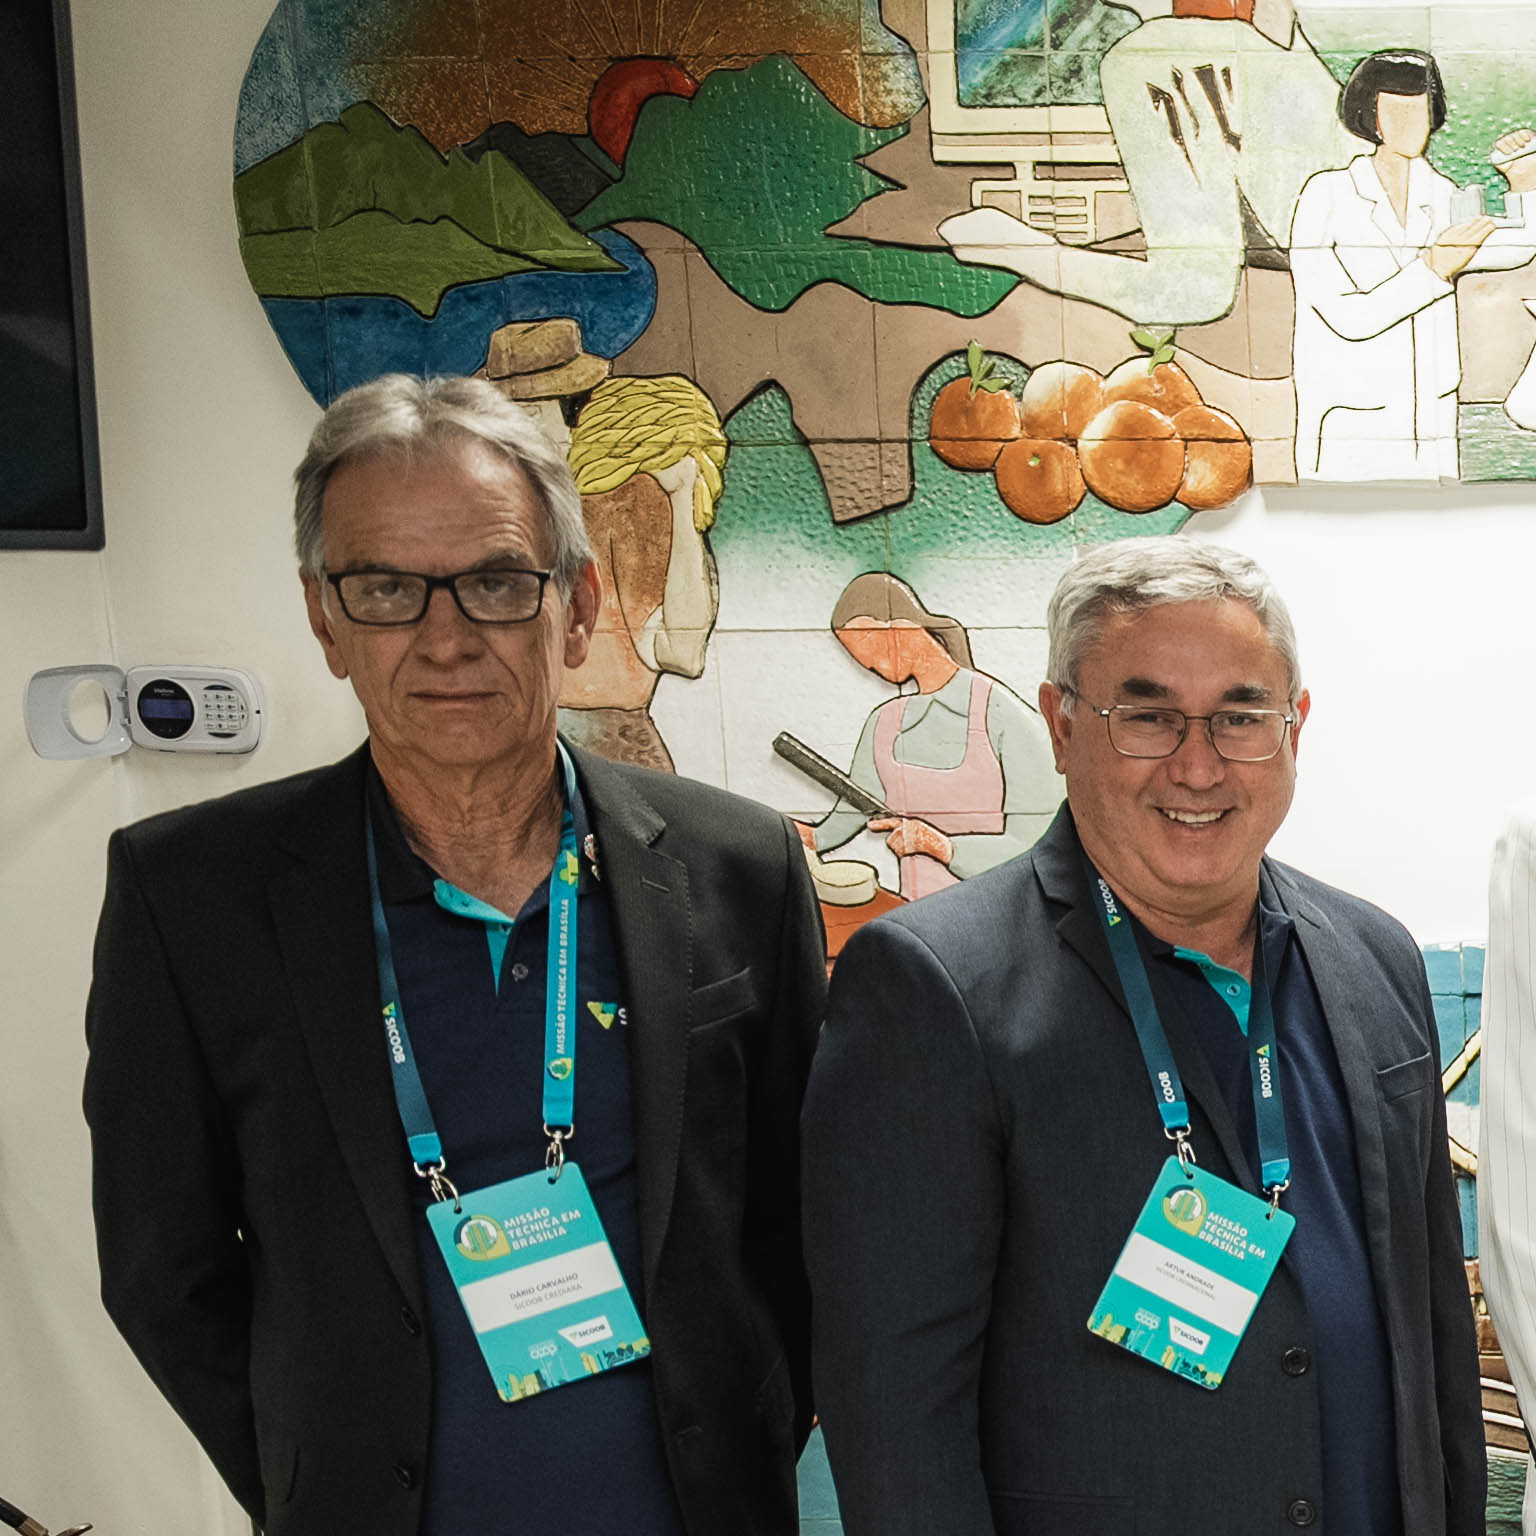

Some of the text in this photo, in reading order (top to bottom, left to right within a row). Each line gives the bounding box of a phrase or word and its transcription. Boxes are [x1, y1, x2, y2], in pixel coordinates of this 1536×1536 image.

[557, 898, 569, 946] BRASÍLIA
[558, 949, 568, 965] EM
[385, 1016, 405, 1064] SICOOB
[555, 1013, 567, 1054] MISSÃO
[1258, 1057, 1272, 1098] SICOOB
[504, 1207, 550, 1230] MISSÃO
[508, 1208, 582, 1240] TÉCNICA EM
[1207, 1211, 1248, 1237] MISSÃO
[511, 1226, 567, 1251] BRASÍLIA
[1198, 1230, 1246, 1260] BRASÍLIA
[1202, 1221, 1266, 1259] TÉCNICA EM
[509, 1272, 579, 1300] DÁRIO CARVALHO
[578, 1324, 606, 1337] SICOOB
[1180, 1331, 1204, 1346] SICOOB
